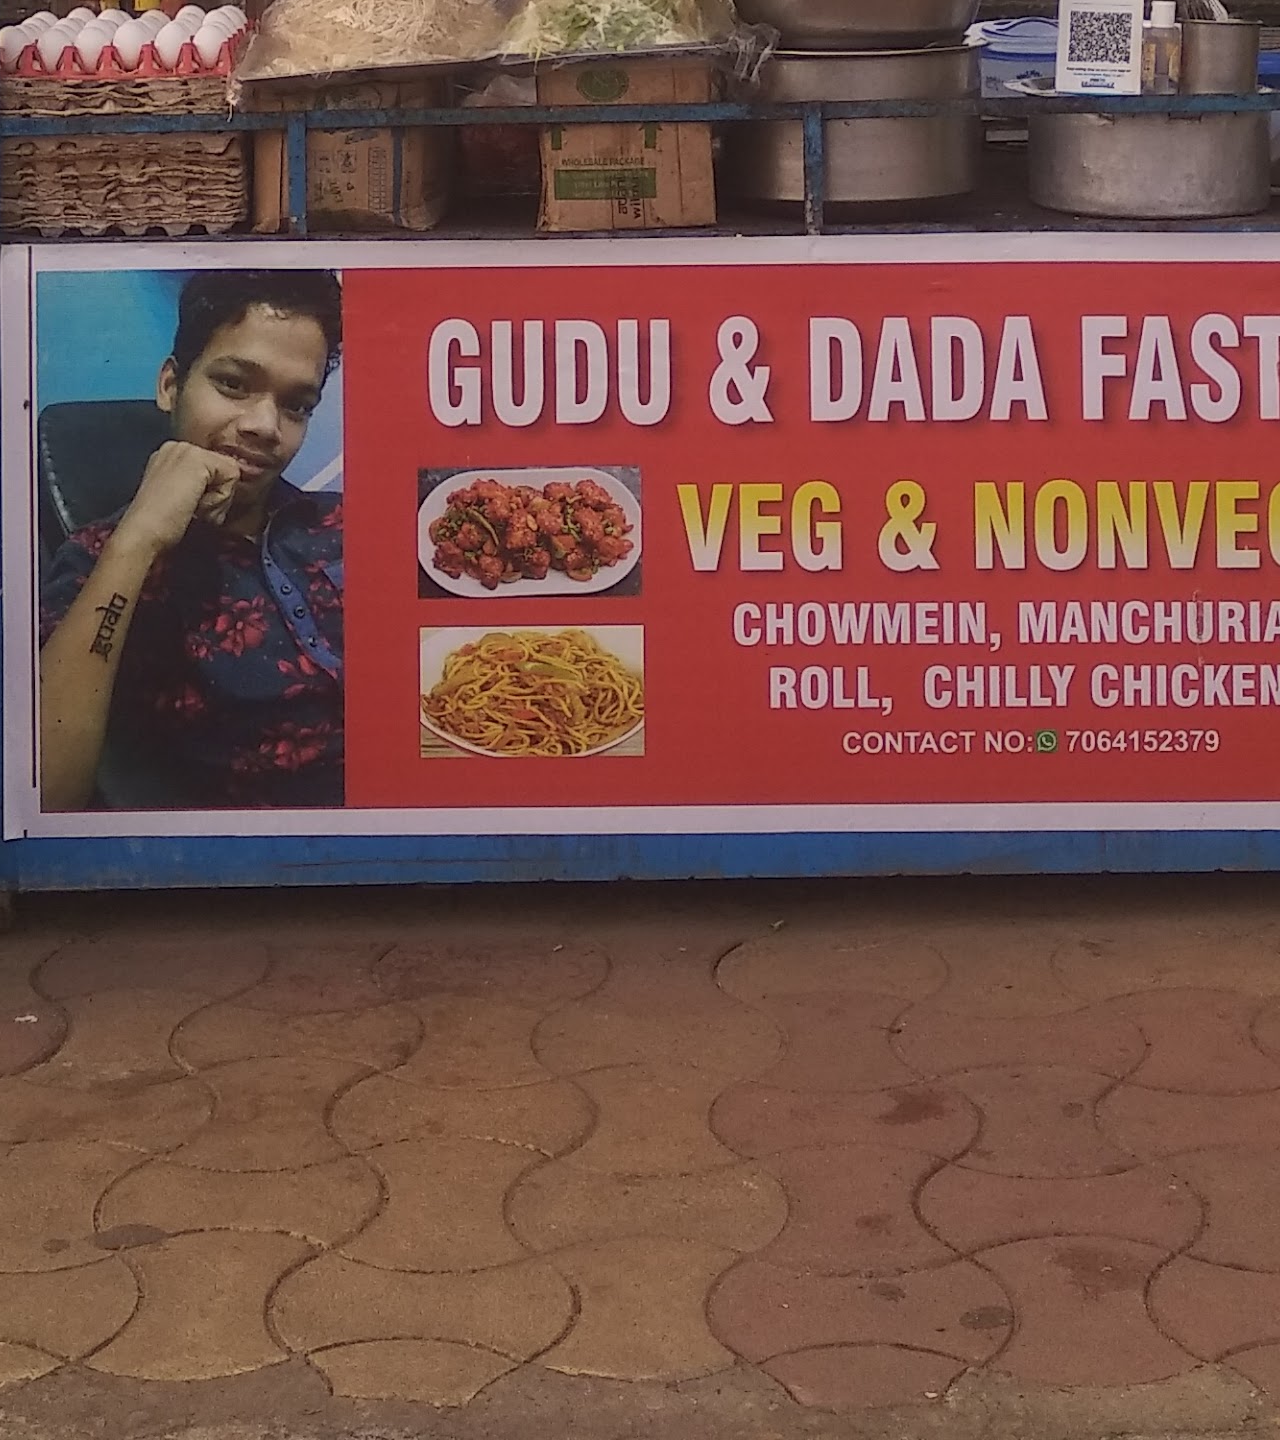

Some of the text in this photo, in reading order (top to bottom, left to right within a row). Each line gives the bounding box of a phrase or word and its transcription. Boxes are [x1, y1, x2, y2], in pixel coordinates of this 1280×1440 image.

[429, 319, 670, 426] GUDU
[710, 316, 773, 424] &
[810, 316, 1047, 421] DADA
[677, 481, 841, 571] VEG
[879, 481, 939, 571] &
[734, 603, 1000, 651] CHOWMEIN,
[770, 666, 892, 715] ROLL,
[925, 666, 1075, 707] CHILLY
[843, 731, 1218, 753] CONTACT NO: 7064152379
